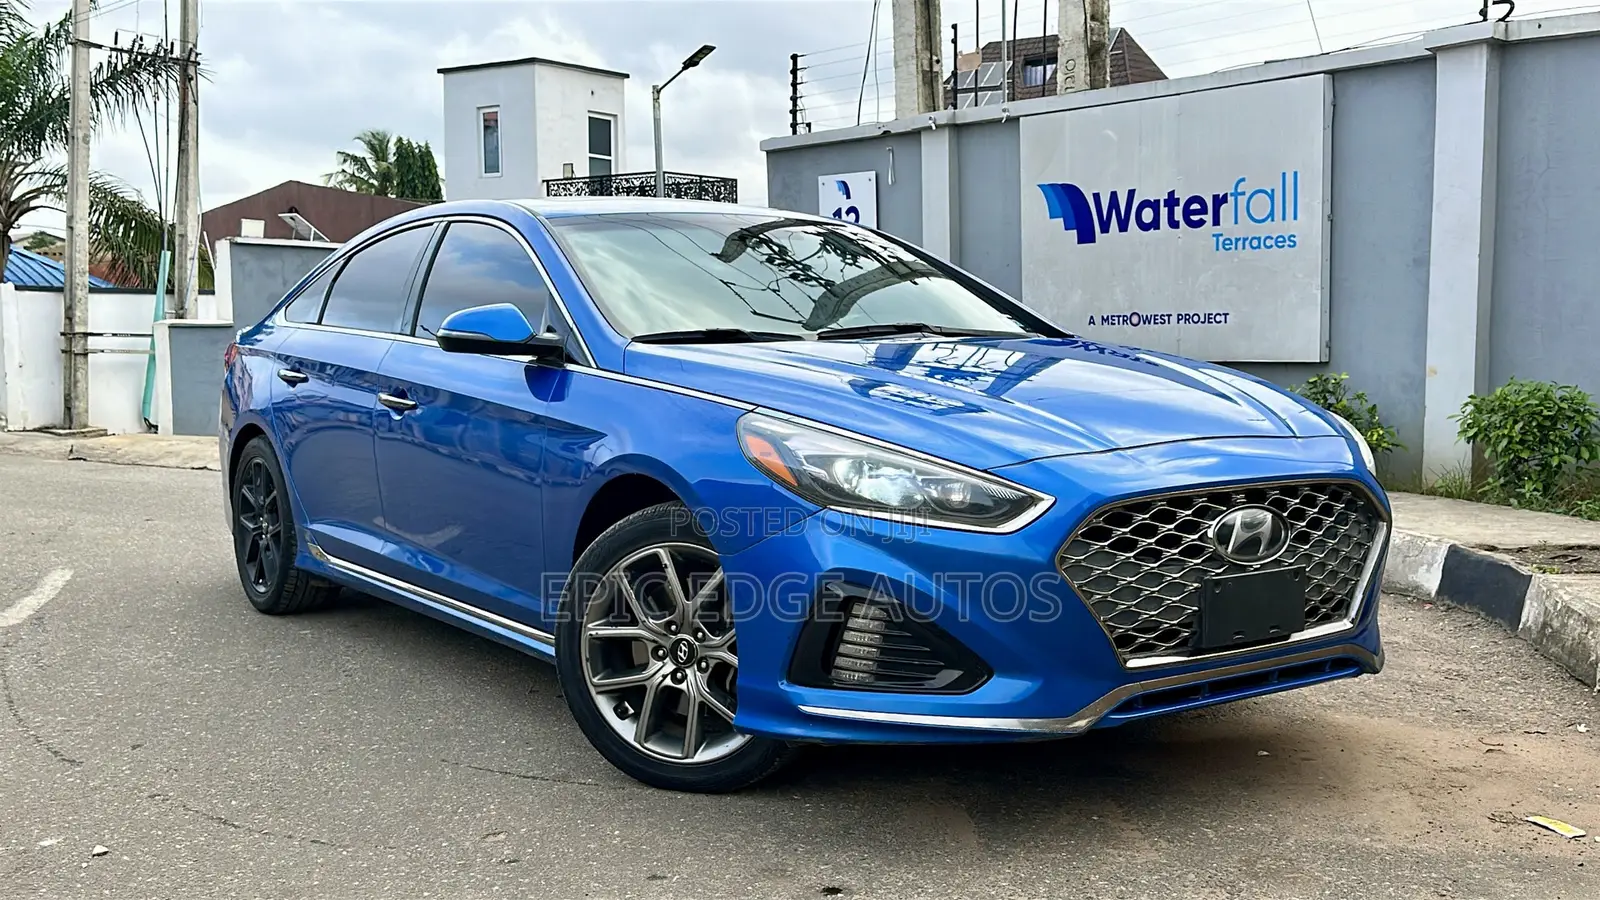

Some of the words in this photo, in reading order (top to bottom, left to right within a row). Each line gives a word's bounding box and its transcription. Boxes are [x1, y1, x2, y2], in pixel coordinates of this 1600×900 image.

[1092, 171, 1298, 234] Waterfall
[1212, 232, 1297, 251] Terraces
[1088, 315, 1096, 326] A
[1101, 311, 1173, 327] METROWEST
[1176, 312, 1230, 325] PROJECT
